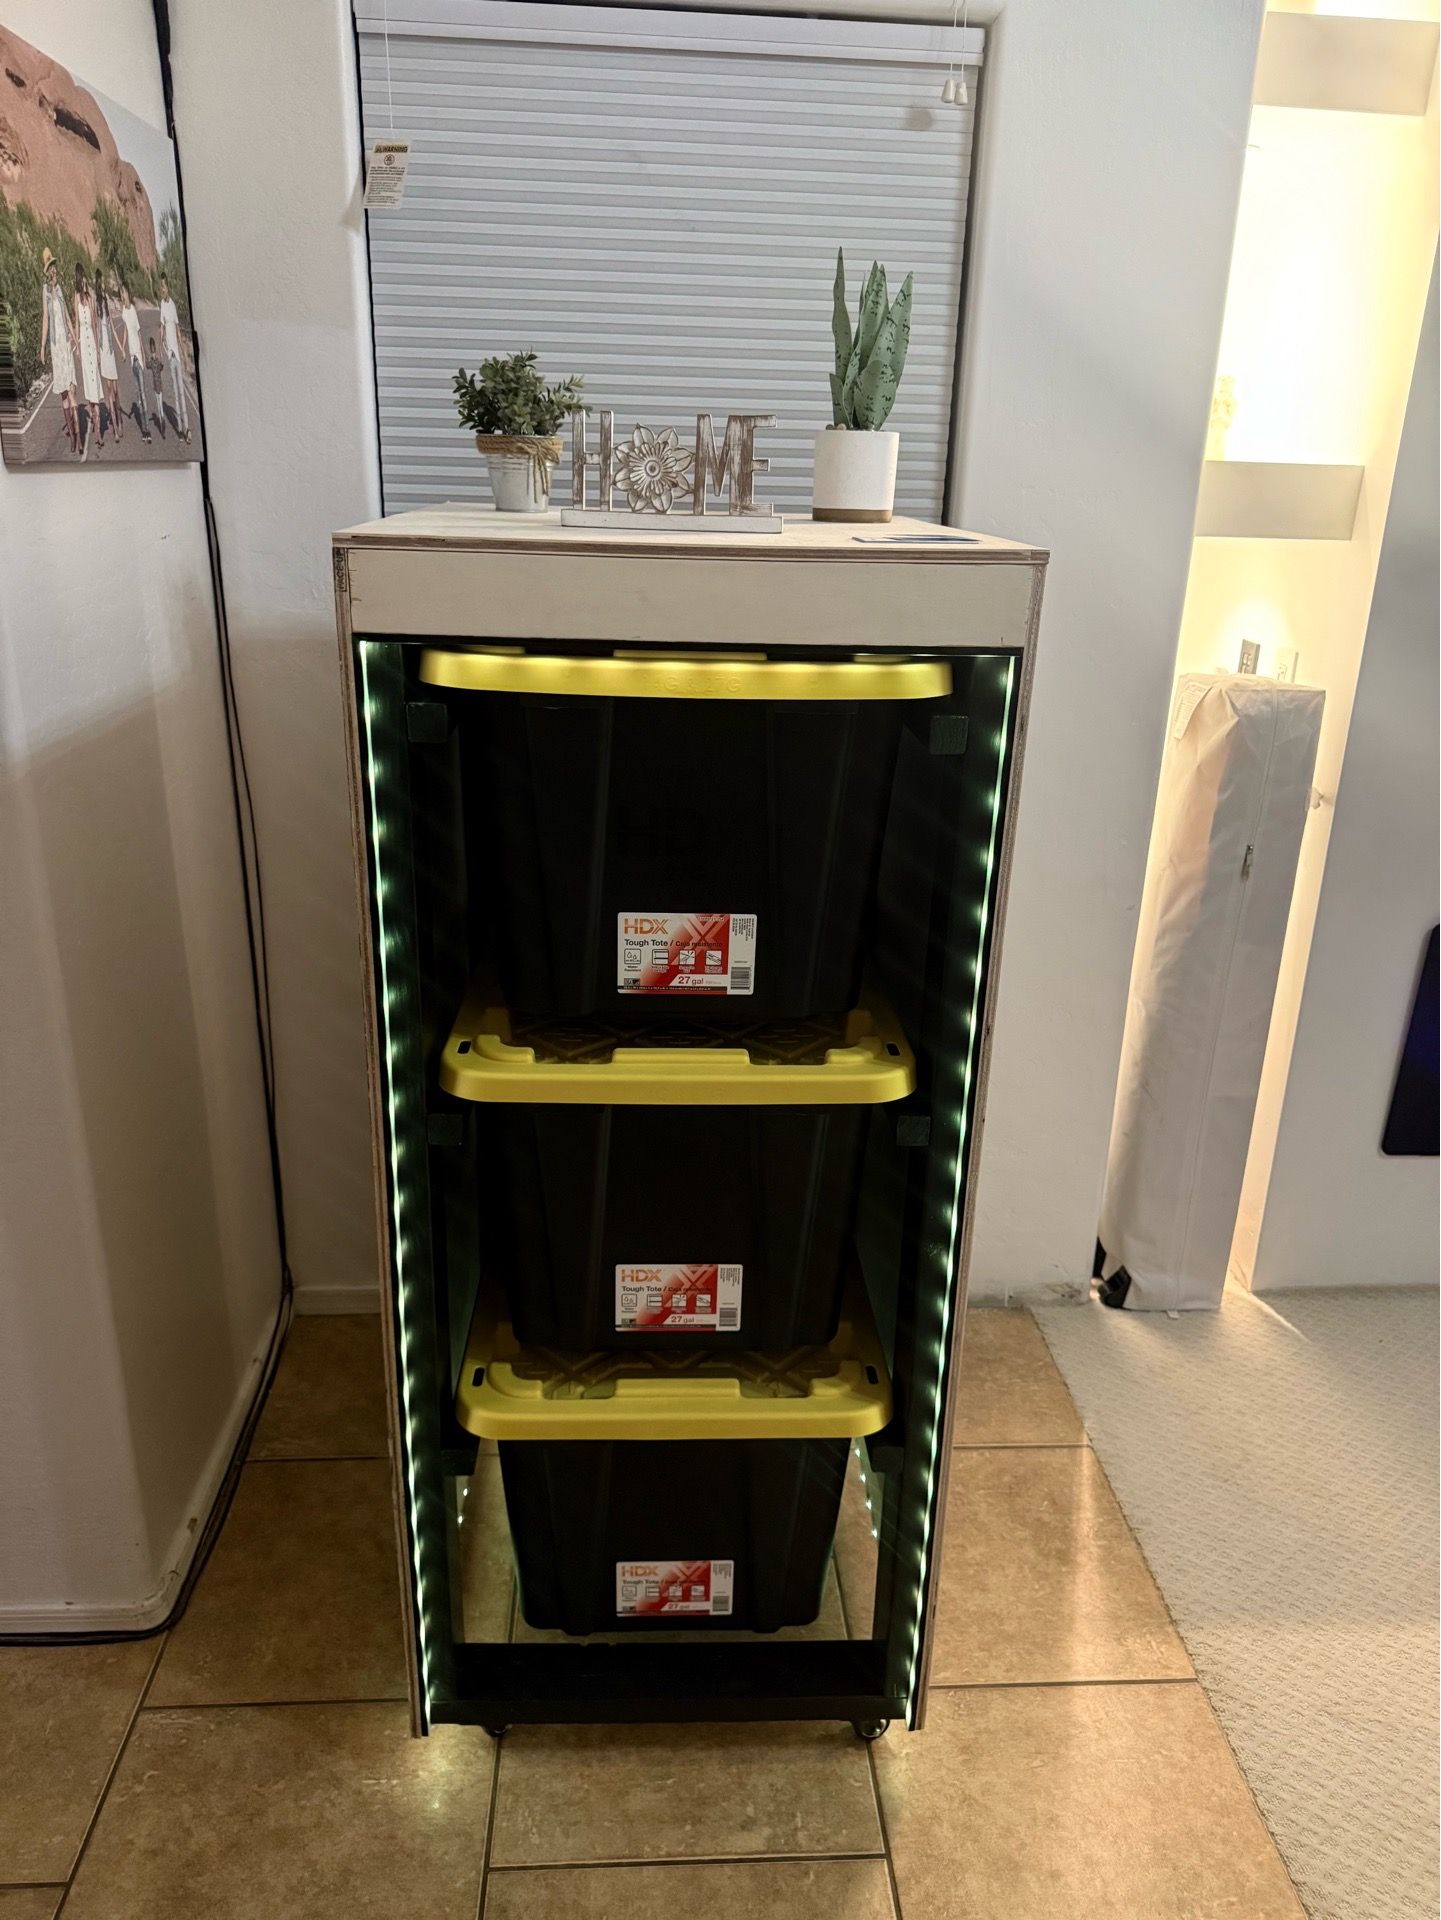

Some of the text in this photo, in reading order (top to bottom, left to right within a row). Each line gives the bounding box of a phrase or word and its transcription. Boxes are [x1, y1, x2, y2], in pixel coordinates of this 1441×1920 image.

[382, 144, 408, 153] WARNING
[624, 918, 670, 935] HDX
[624, 939, 649, 947] Tough
[678, 975, 691, 984] 27
[621, 1269, 662, 1282] HDX
[671, 1315, 682, 1323] 27
[622, 1565, 659, 1577] HDX
